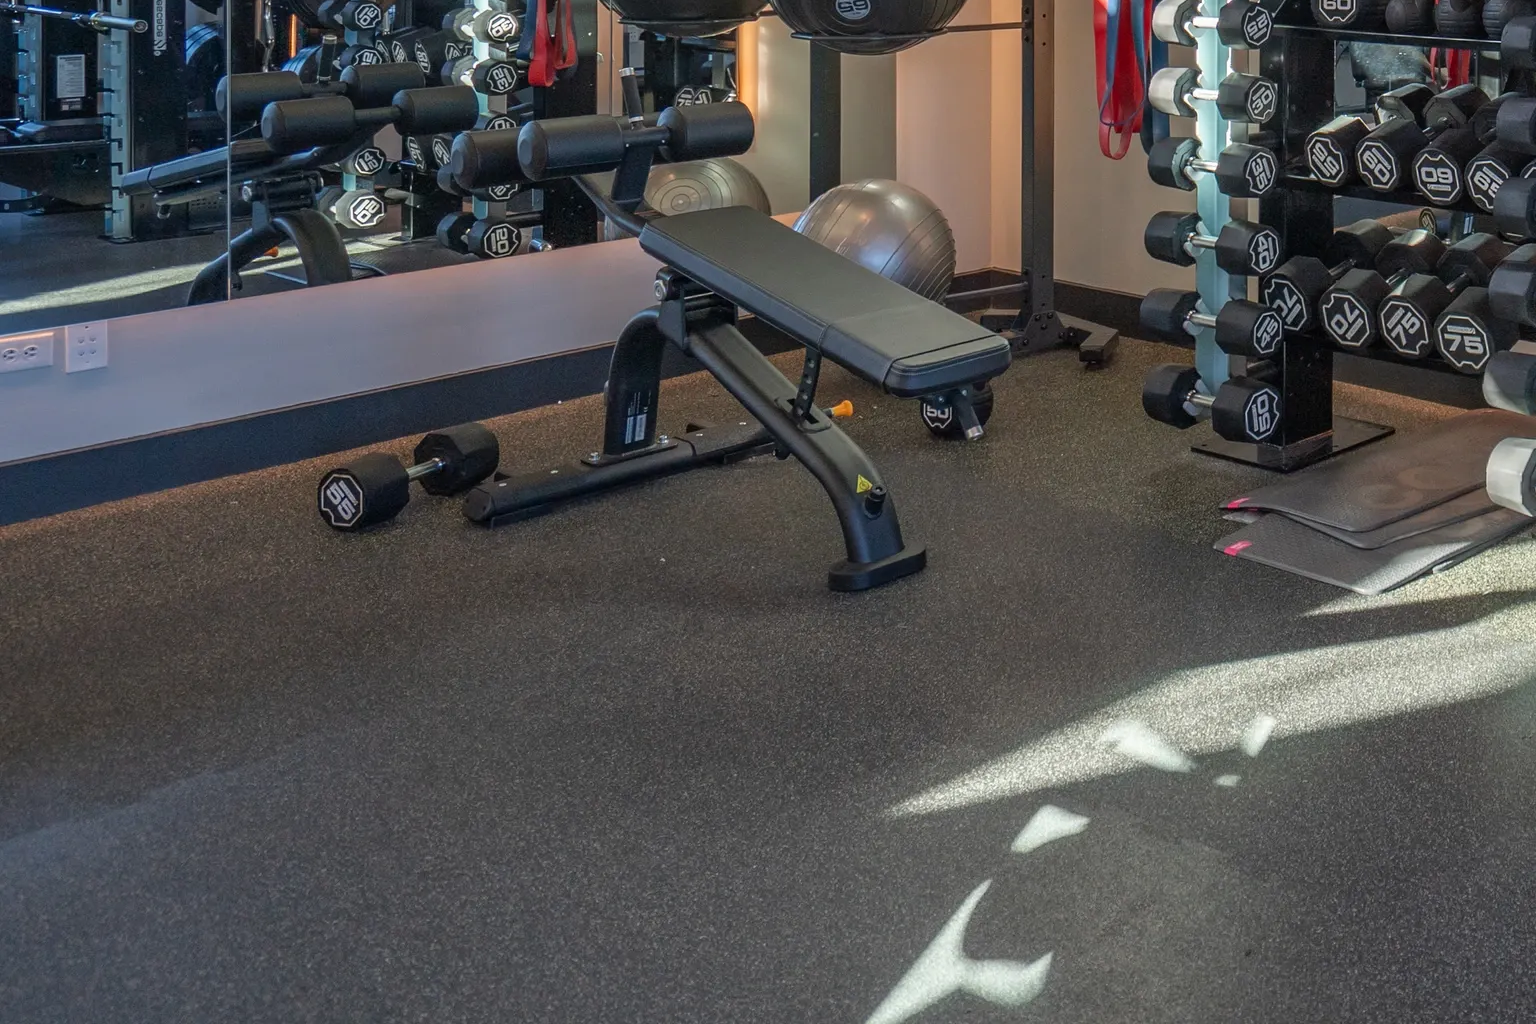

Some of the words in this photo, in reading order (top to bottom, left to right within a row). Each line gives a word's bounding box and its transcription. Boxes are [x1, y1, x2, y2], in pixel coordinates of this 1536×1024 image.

[1247, 15, 1268, 35] 25
[1252, 90, 1272, 113] 30
[1252, 158, 1269, 189] 35
[1313, 142, 1340, 177] 55
[1363, 150, 1390, 183] 60
[1420, 167, 1454, 184] 60
[1256, 236, 1269, 269] 40
[1331, 301, 1359, 332] 70
[1391, 313, 1420, 346] 75
[1259, 319, 1280, 349] 45
[1444, 333, 1484, 354] 75
[1255, 397, 1270, 432] 50
[326, 482, 356, 520] 55
